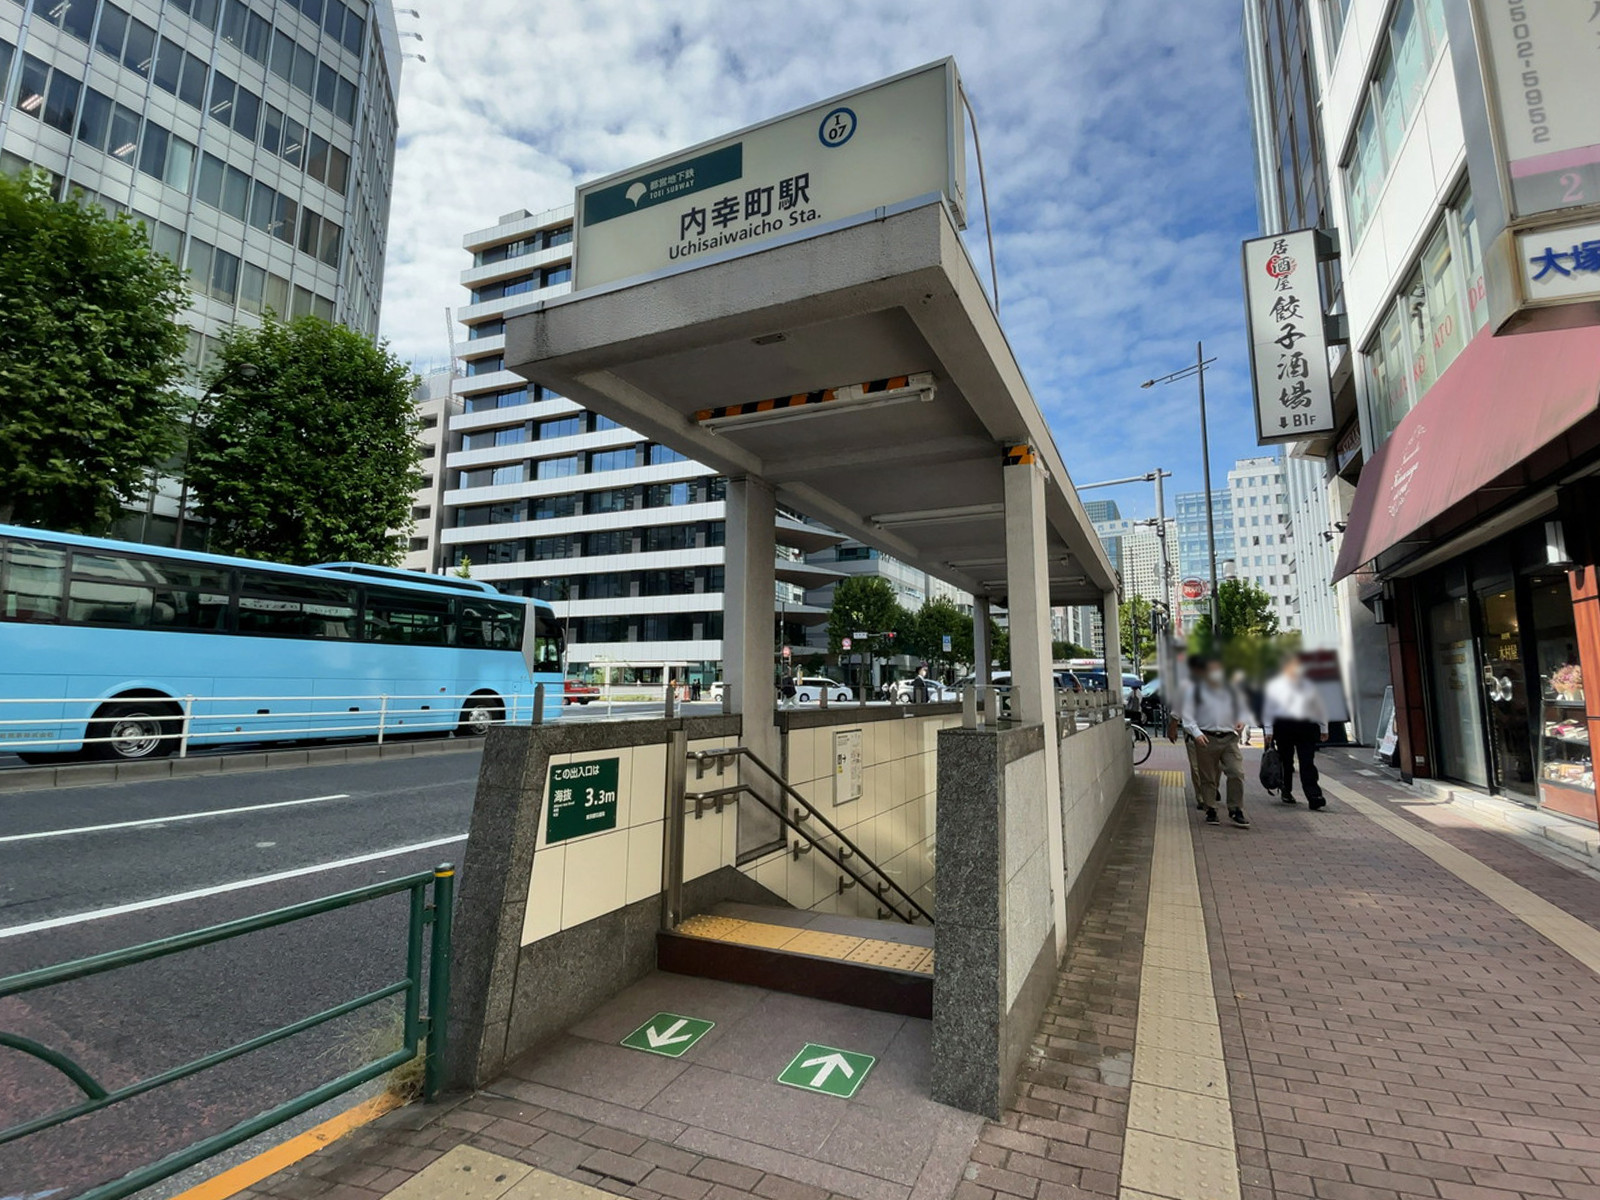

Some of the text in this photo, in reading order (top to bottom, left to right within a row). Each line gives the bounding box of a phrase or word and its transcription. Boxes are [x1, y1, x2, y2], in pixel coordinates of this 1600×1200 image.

[834, 114, 842, 126] I
[828, 124, 847, 140] 07
[650, 168, 695, 190] 都営地下鉄
[650, 179, 695, 199] TOEI SUBWAY
[1559, 172, 1585, 203] 2
[680, 172, 810, 241] 内幸町駅
[669, 209, 822, 260] Uchisaiwaicho Sta.
[1270, 238, 1293, 292] 居酒屋
[1269, 295, 1312, 410] 餃子酒場
[1294, 412, 1316, 427] B1F
[554, 765, 600, 781] この出入口は
[553, 788, 573, 803] 海抜
[584, 787, 615, 807] 3.3m
